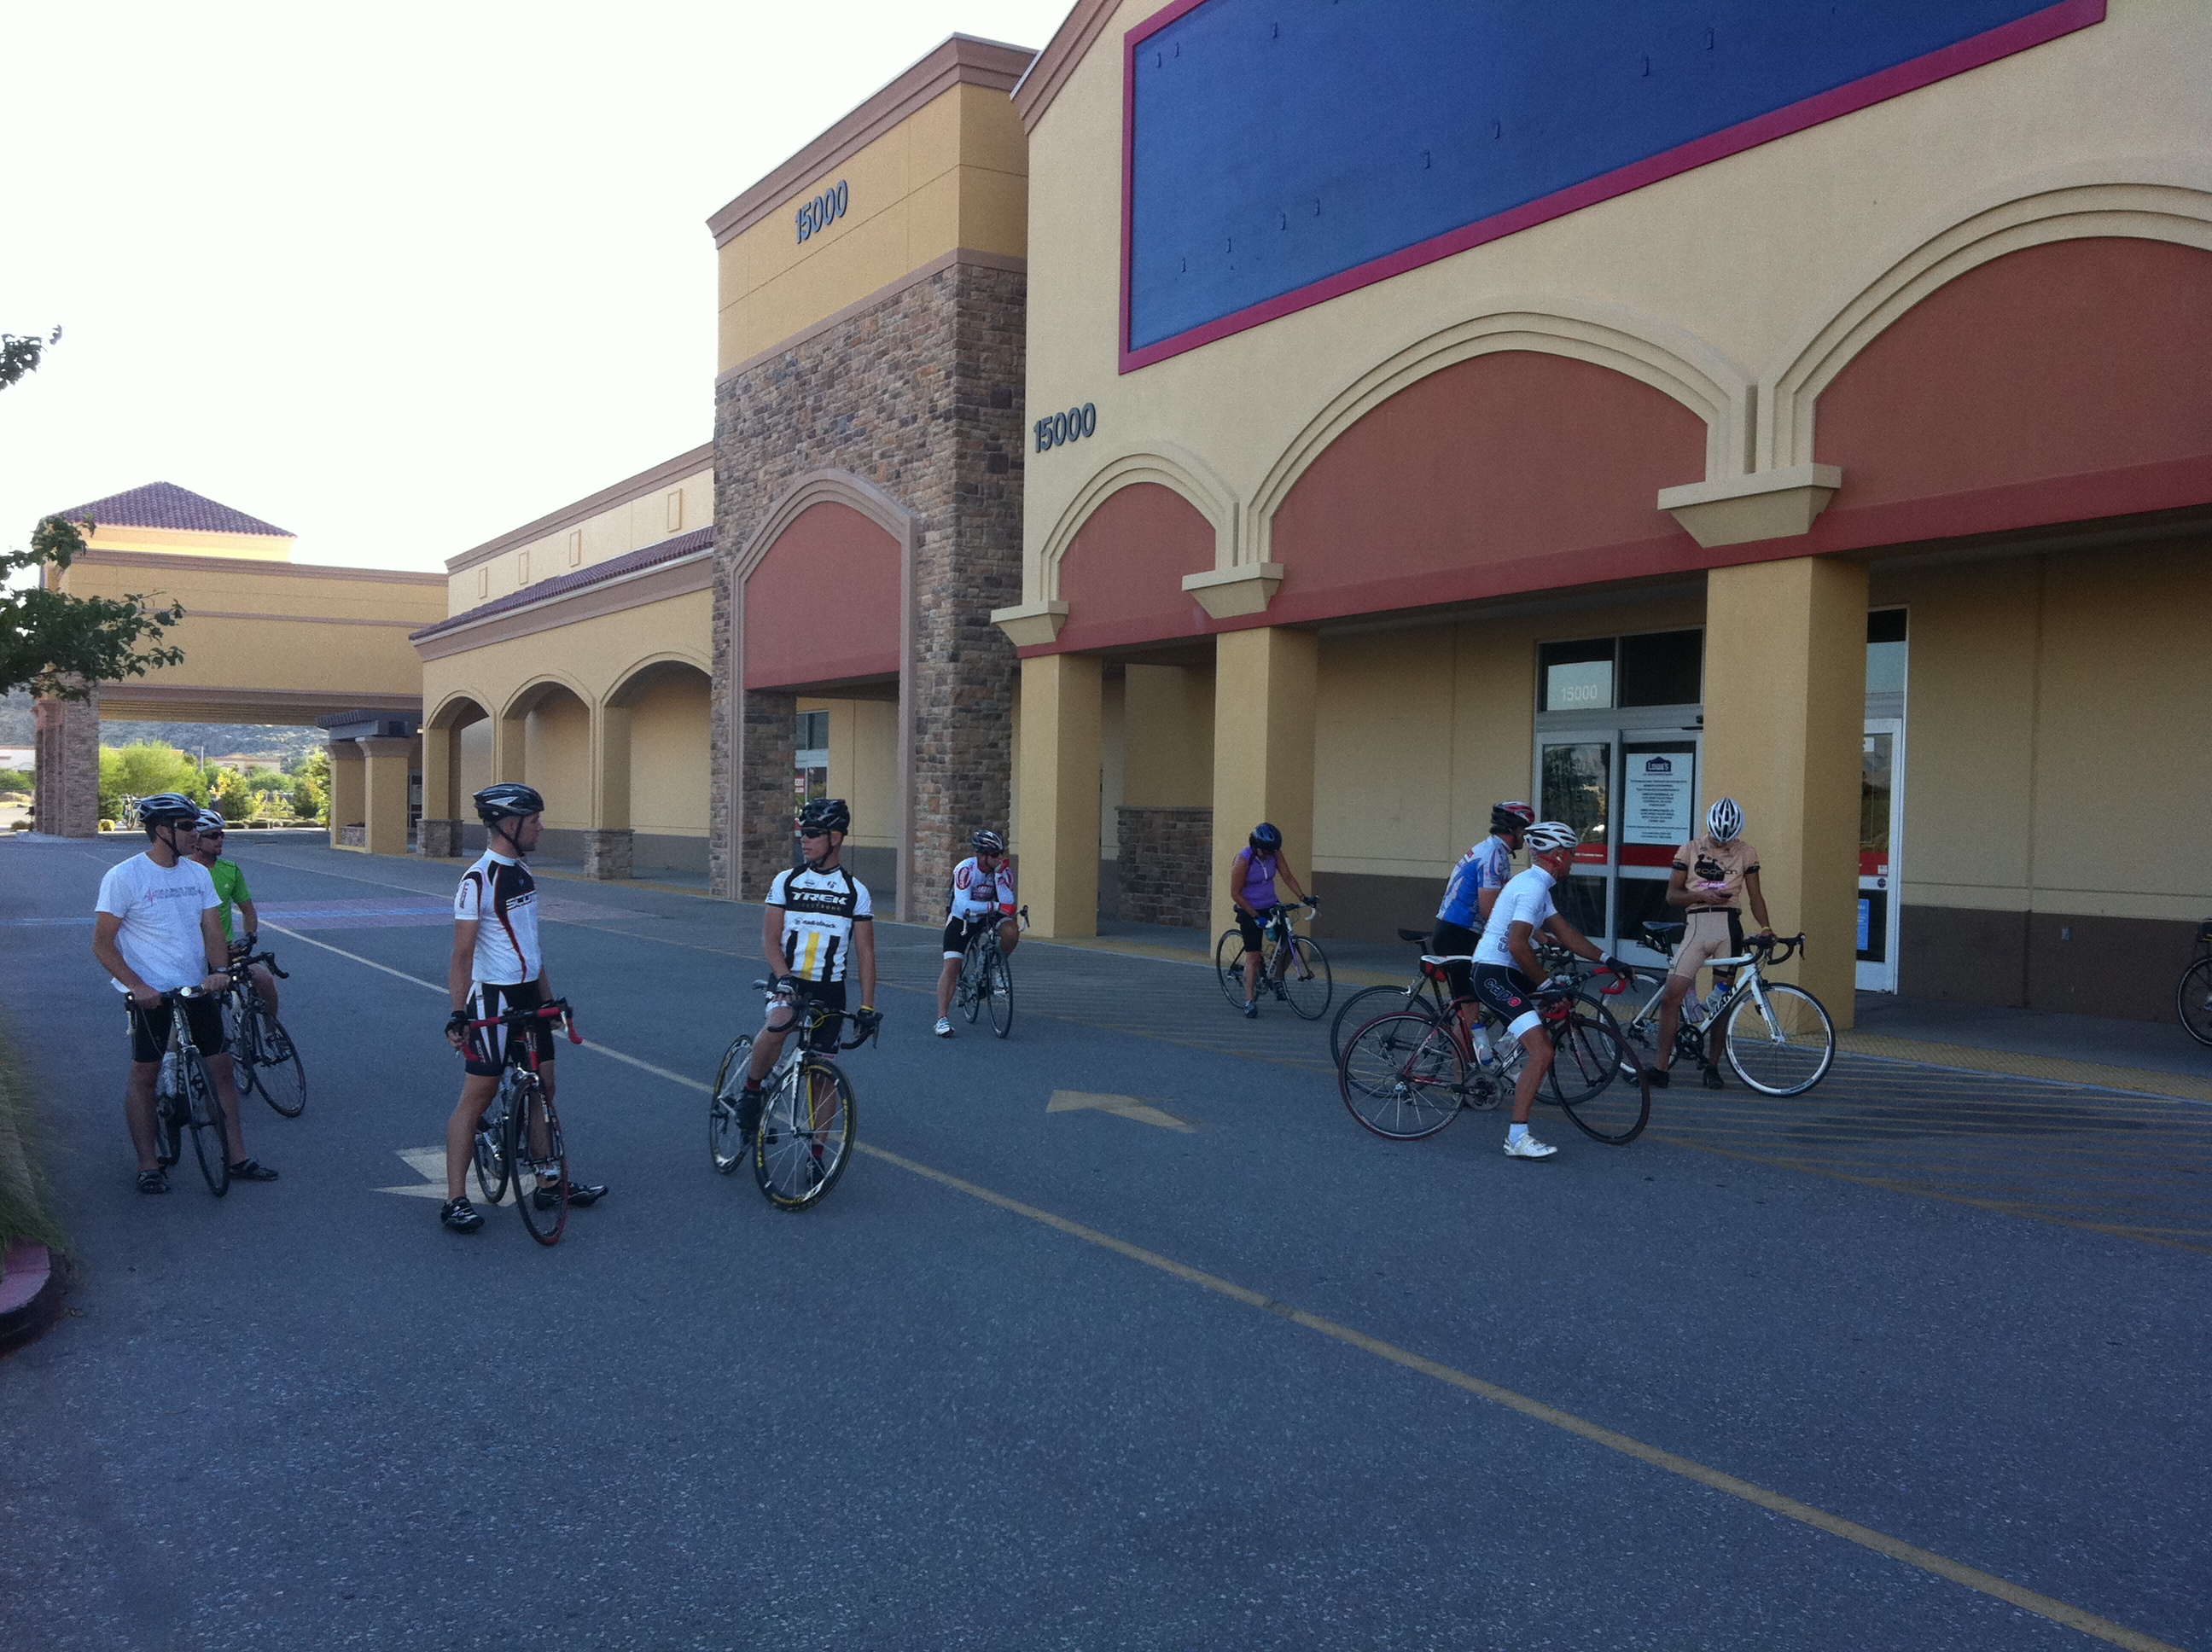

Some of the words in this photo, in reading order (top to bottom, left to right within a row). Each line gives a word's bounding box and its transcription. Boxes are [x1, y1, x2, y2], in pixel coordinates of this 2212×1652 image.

[795, 179, 848, 244] 15000
[1033, 403, 1096, 453] 15000
[1562, 684, 1598, 701] 15000
[791, 892, 848, 905] TREK
[1708, 983, 1738, 1021] GIANT
